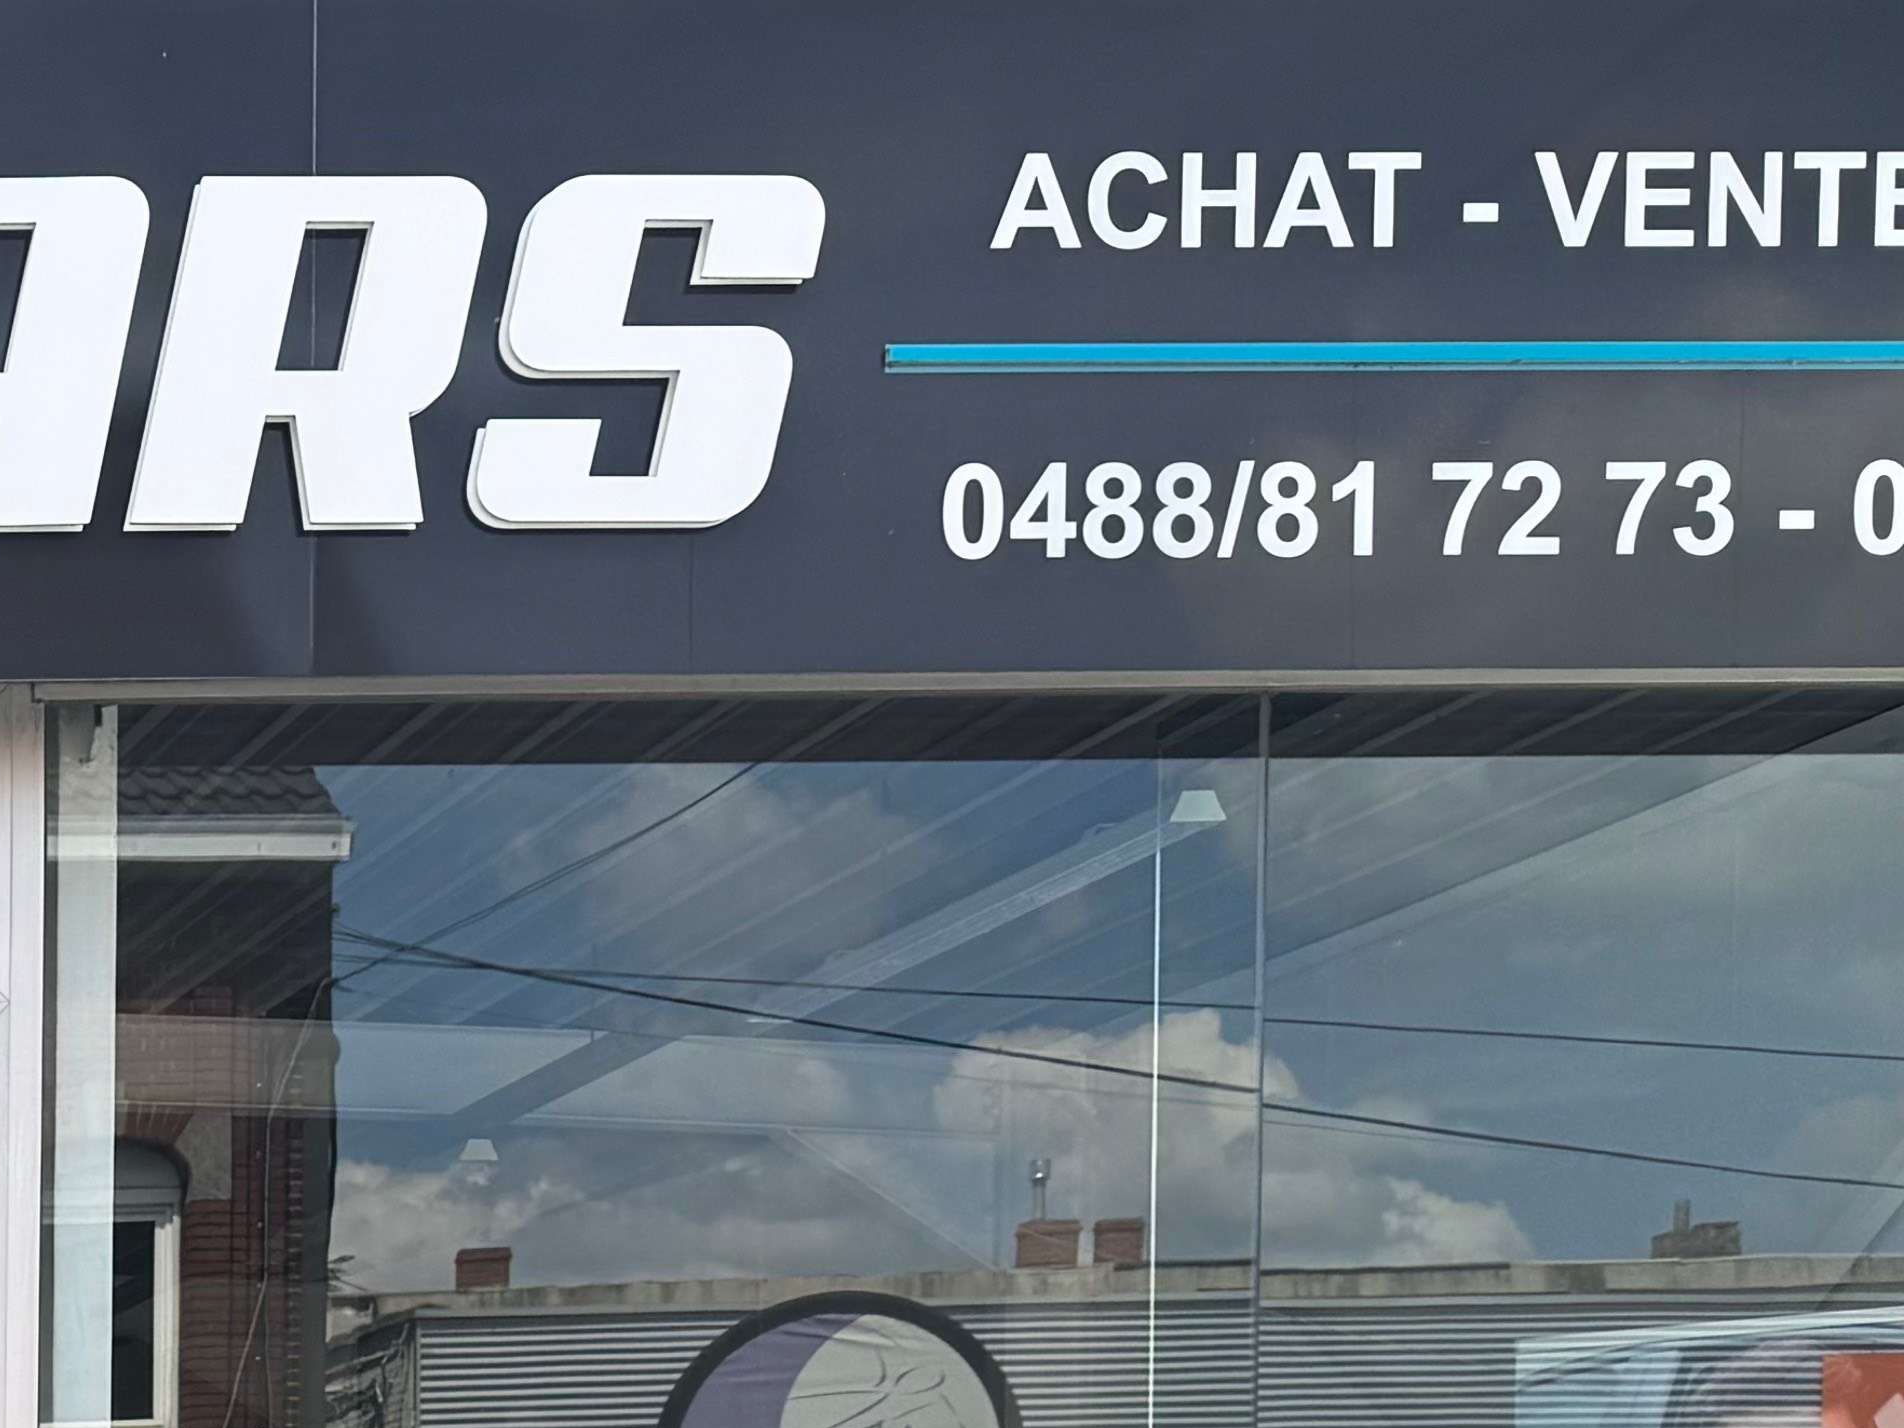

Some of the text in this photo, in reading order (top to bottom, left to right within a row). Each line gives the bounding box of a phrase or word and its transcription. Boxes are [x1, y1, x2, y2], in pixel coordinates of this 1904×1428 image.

[990, 151, 1422, 250] ACHAT
[941, 460, 1375, 561] 0488/81
[1431, 461, 1562, 559] 72
[1605, 459, 1735, 557] 73
